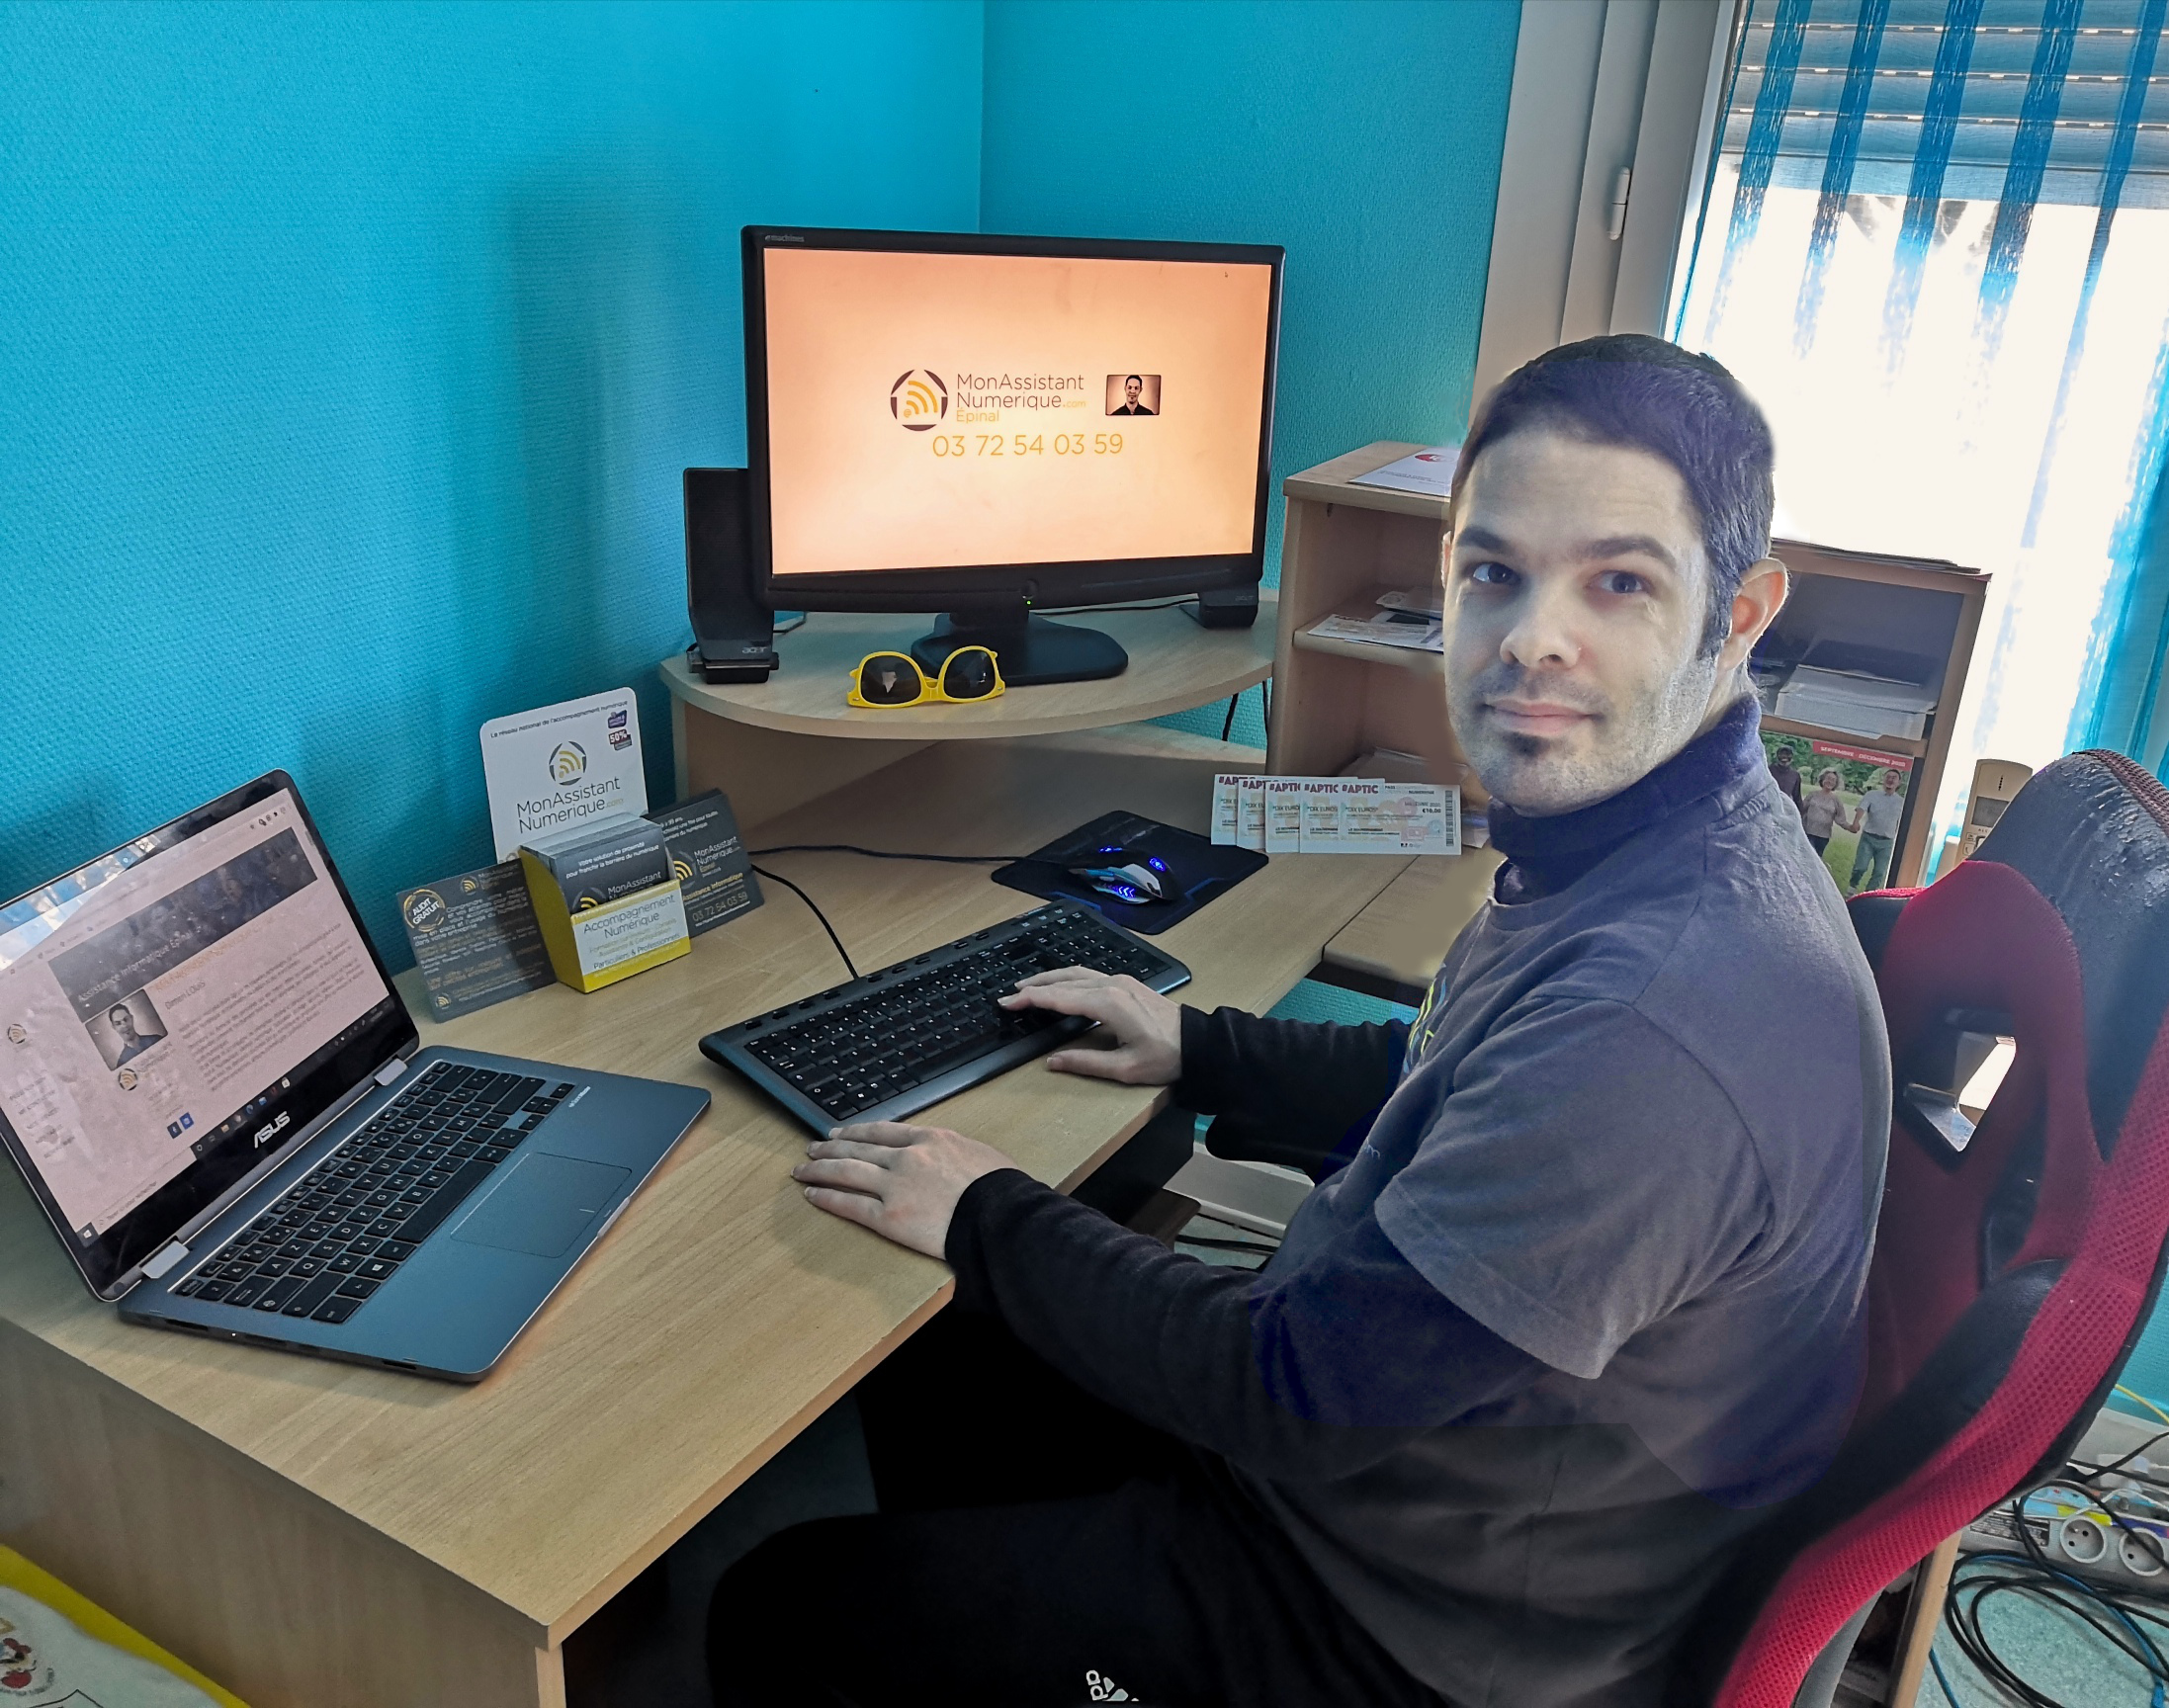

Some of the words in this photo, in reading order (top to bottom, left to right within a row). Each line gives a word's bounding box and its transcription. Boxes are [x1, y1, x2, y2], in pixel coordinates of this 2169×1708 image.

[957, 373, 1084, 391] MonAssistant
[956, 406, 1000, 424] Épinal
[932, 435, 966, 457] 03
[975, 435, 1004, 456] 72
[1013, 434, 1044, 456] 54
[1054, 433, 1084, 455] 03
[1093, 433, 1124, 454] 59
[741, 645, 767, 655] acer
[609, 731, 628, 743] 50%
[1820, 746, 1855, 757] SEPTEMBRE
[517, 776, 621, 817] MonAssistant
[694, 835, 737, 859] MonAssistant
[607, 871, 662, 895] MonAssistant
[411, 897, 432, 916] AUDIT
[412, 900, 441, 925] GRATUIT
[446, 898, 483, 913] Comprendre
[583, 894, 676, 934] Accompagnement
[693, 911, 704, 922] 03
[706, 906, 714, 915] 72
[728, 897, 737, 906] 03
[738, 891, 748, 900] 59
[604, 910, 660, 939] Numérique
[78, 974, 121, 1002] Assistance
[121, 945, 170, 977] Informatique
[253, 1110, 291, 1149] ASUS
